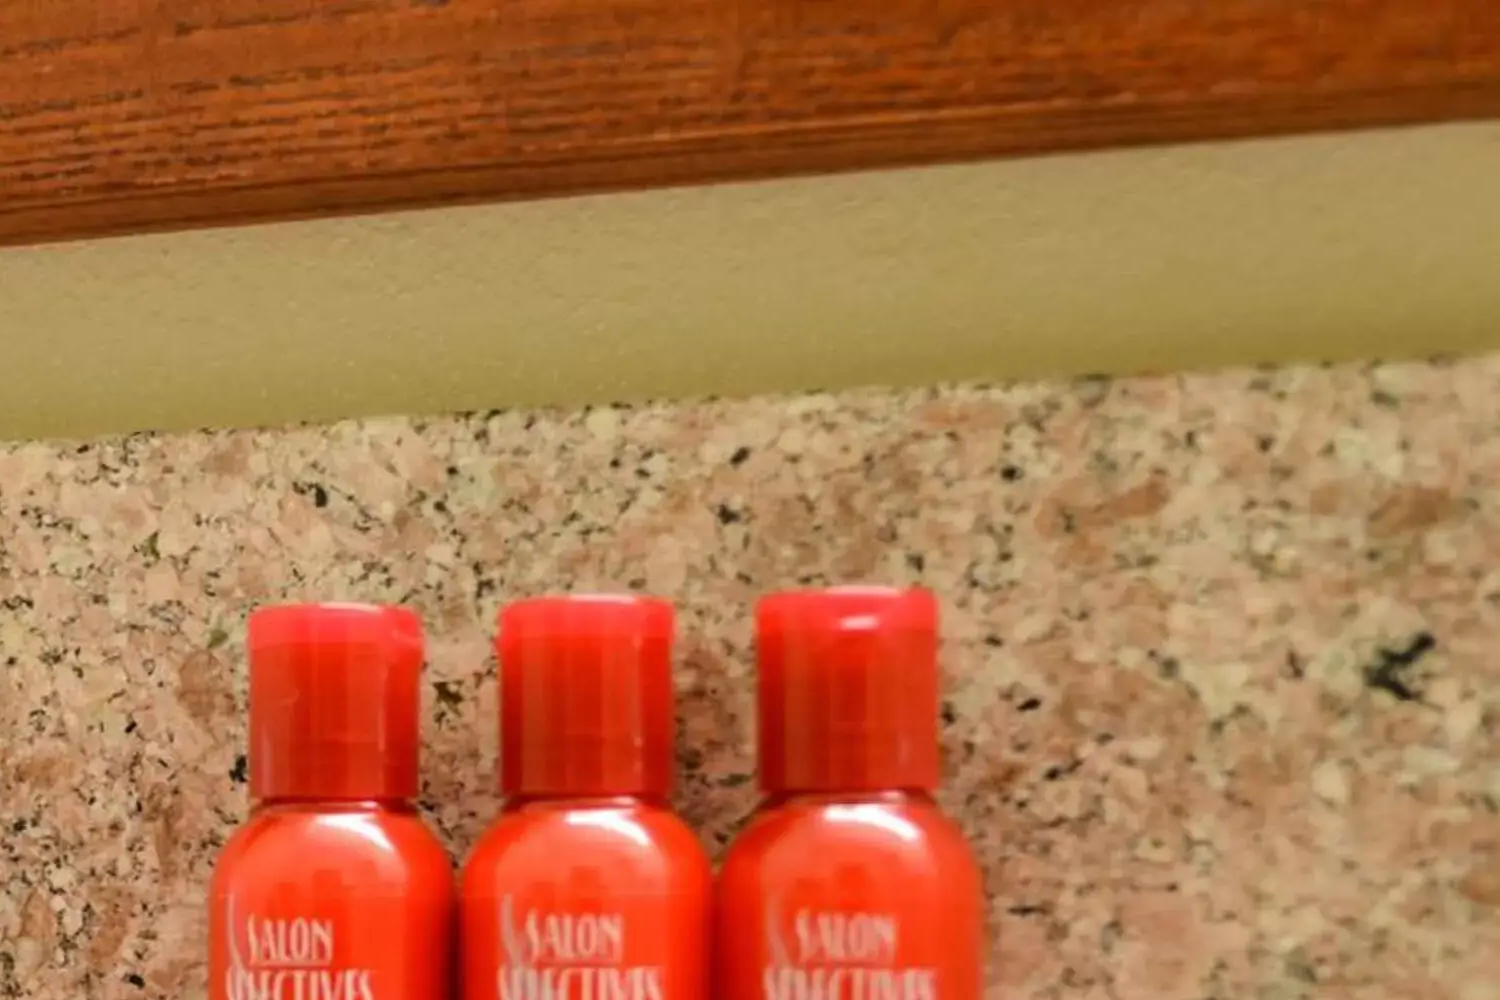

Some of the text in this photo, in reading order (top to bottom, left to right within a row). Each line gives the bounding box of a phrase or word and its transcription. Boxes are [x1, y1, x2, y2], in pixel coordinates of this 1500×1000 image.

[247, 913, 333, 966] SALON
[525, 910, 623, 963] SALON
[795, 909, 897, 962] SALON
